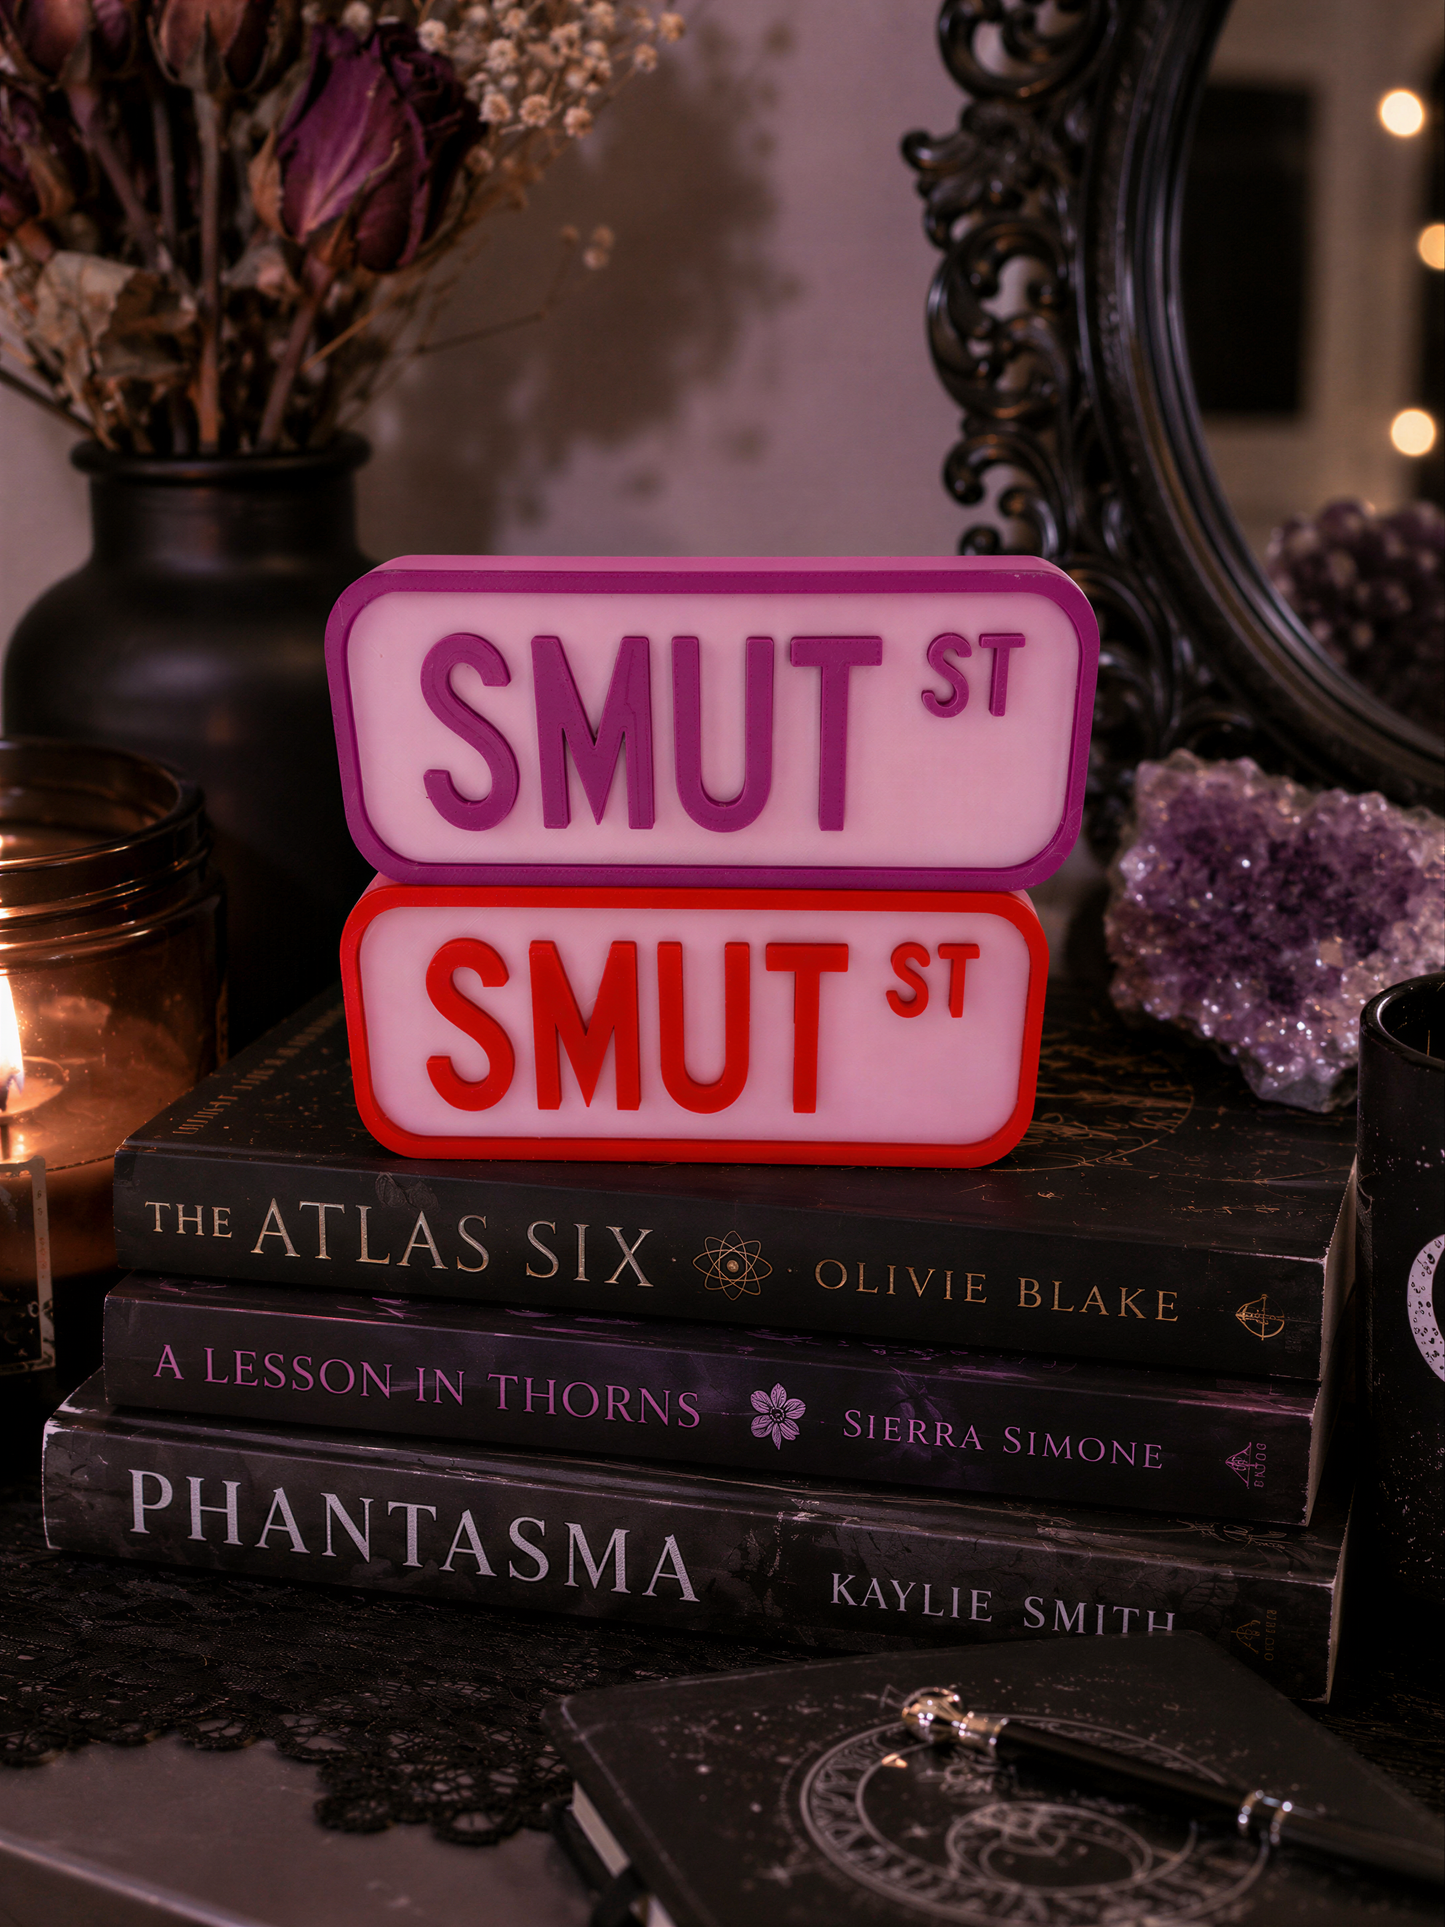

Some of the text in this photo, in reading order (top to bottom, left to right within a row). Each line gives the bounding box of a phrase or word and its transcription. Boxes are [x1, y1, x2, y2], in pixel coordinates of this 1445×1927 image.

[420, 632, 1026, 833] SMUT ST
[425, 937, 850, 1114] SMUT
[885, 942, 981, 1018] ST
[145, 1197, 654, 1288] THE ATLAS SIX
[814, 1258, 1180, 1322] OLIVIE BLAKE
[153, 1344, 701, 1429] A LESSON IN THORNS
[842, 1408, 1164, 1470] SIERRA SIMONE
[127, 1468, 701, 1603] PHANTASMA
[830, 1572, 1176, 1636] KAYLIE SMITH
